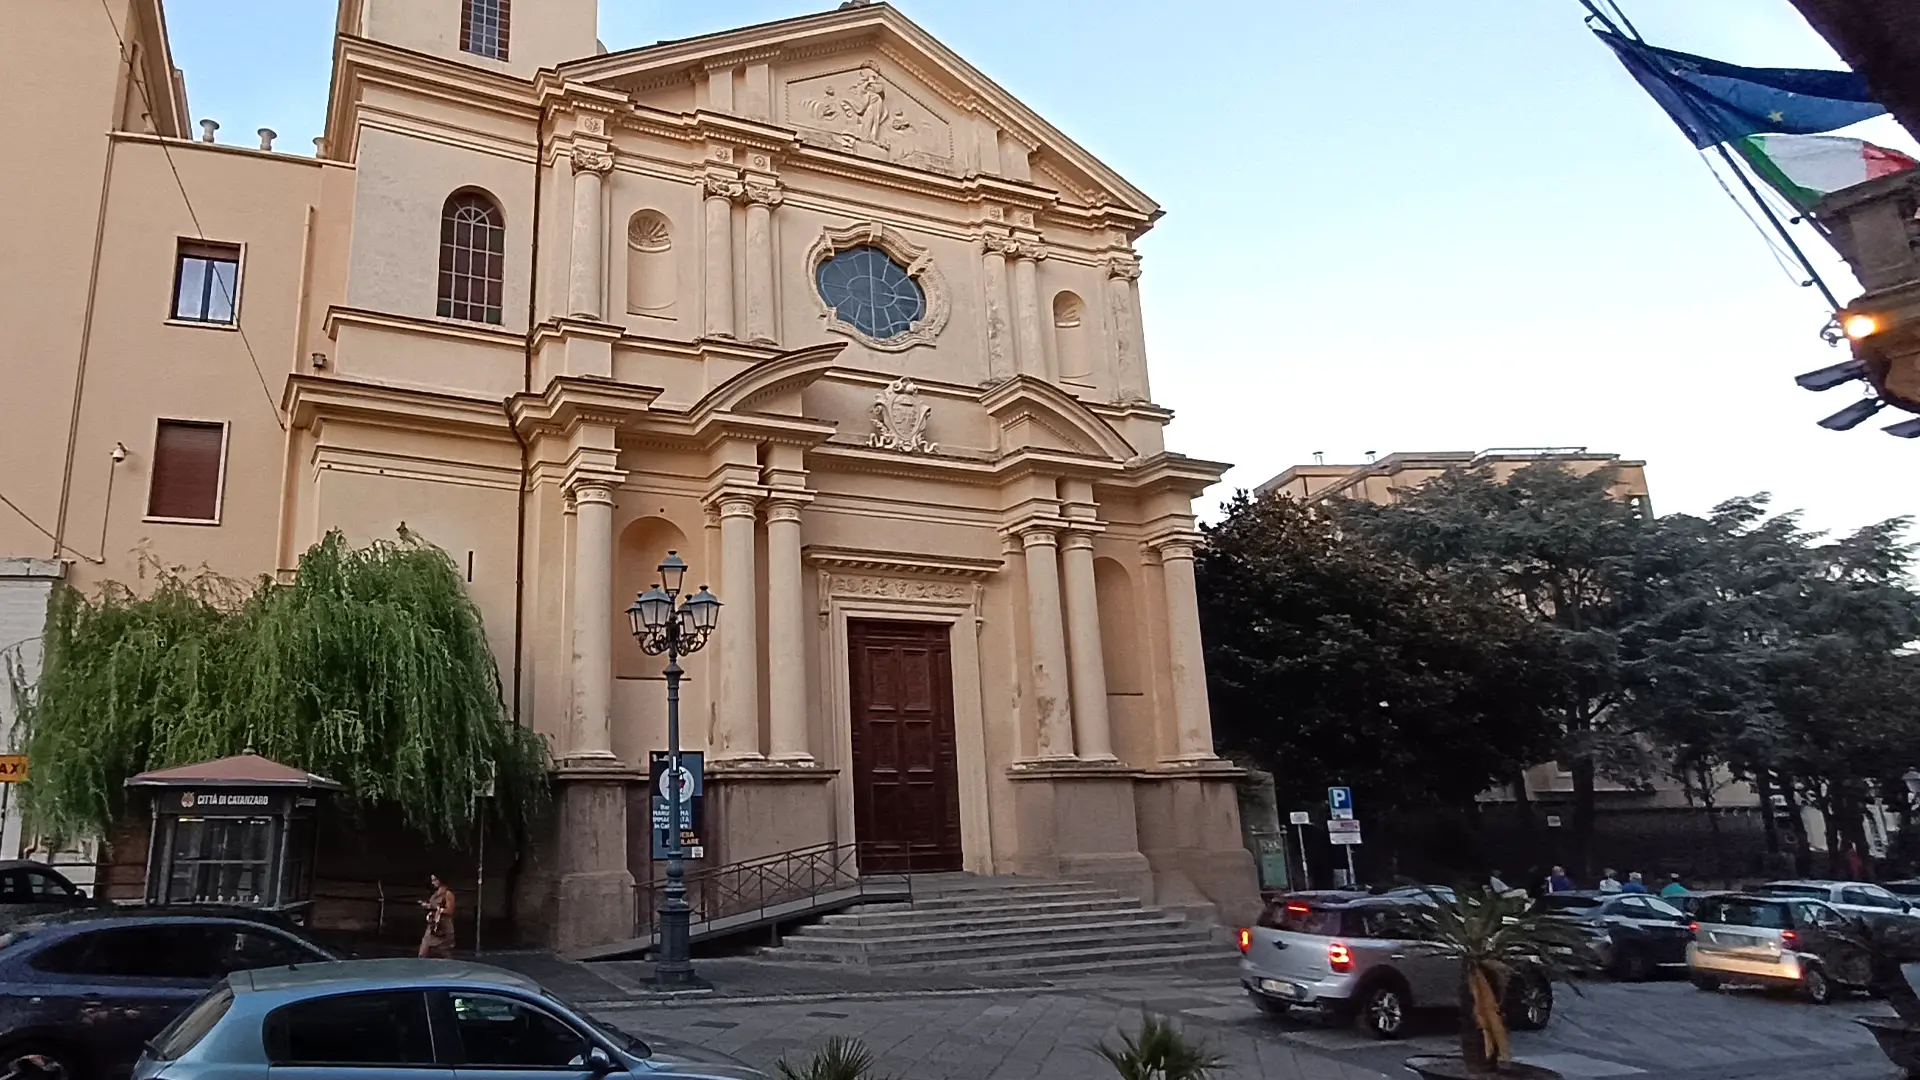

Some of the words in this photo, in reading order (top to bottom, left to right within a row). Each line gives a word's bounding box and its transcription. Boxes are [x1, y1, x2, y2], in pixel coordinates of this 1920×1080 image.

[0, 763, 26, 774] AXI
[197, 793, 218, 805] CITTÀ
[218, 795, 226, 805] DI
[227, 795, 269, 805] CATANZARO
[1333, 789, 1346, 808] P
